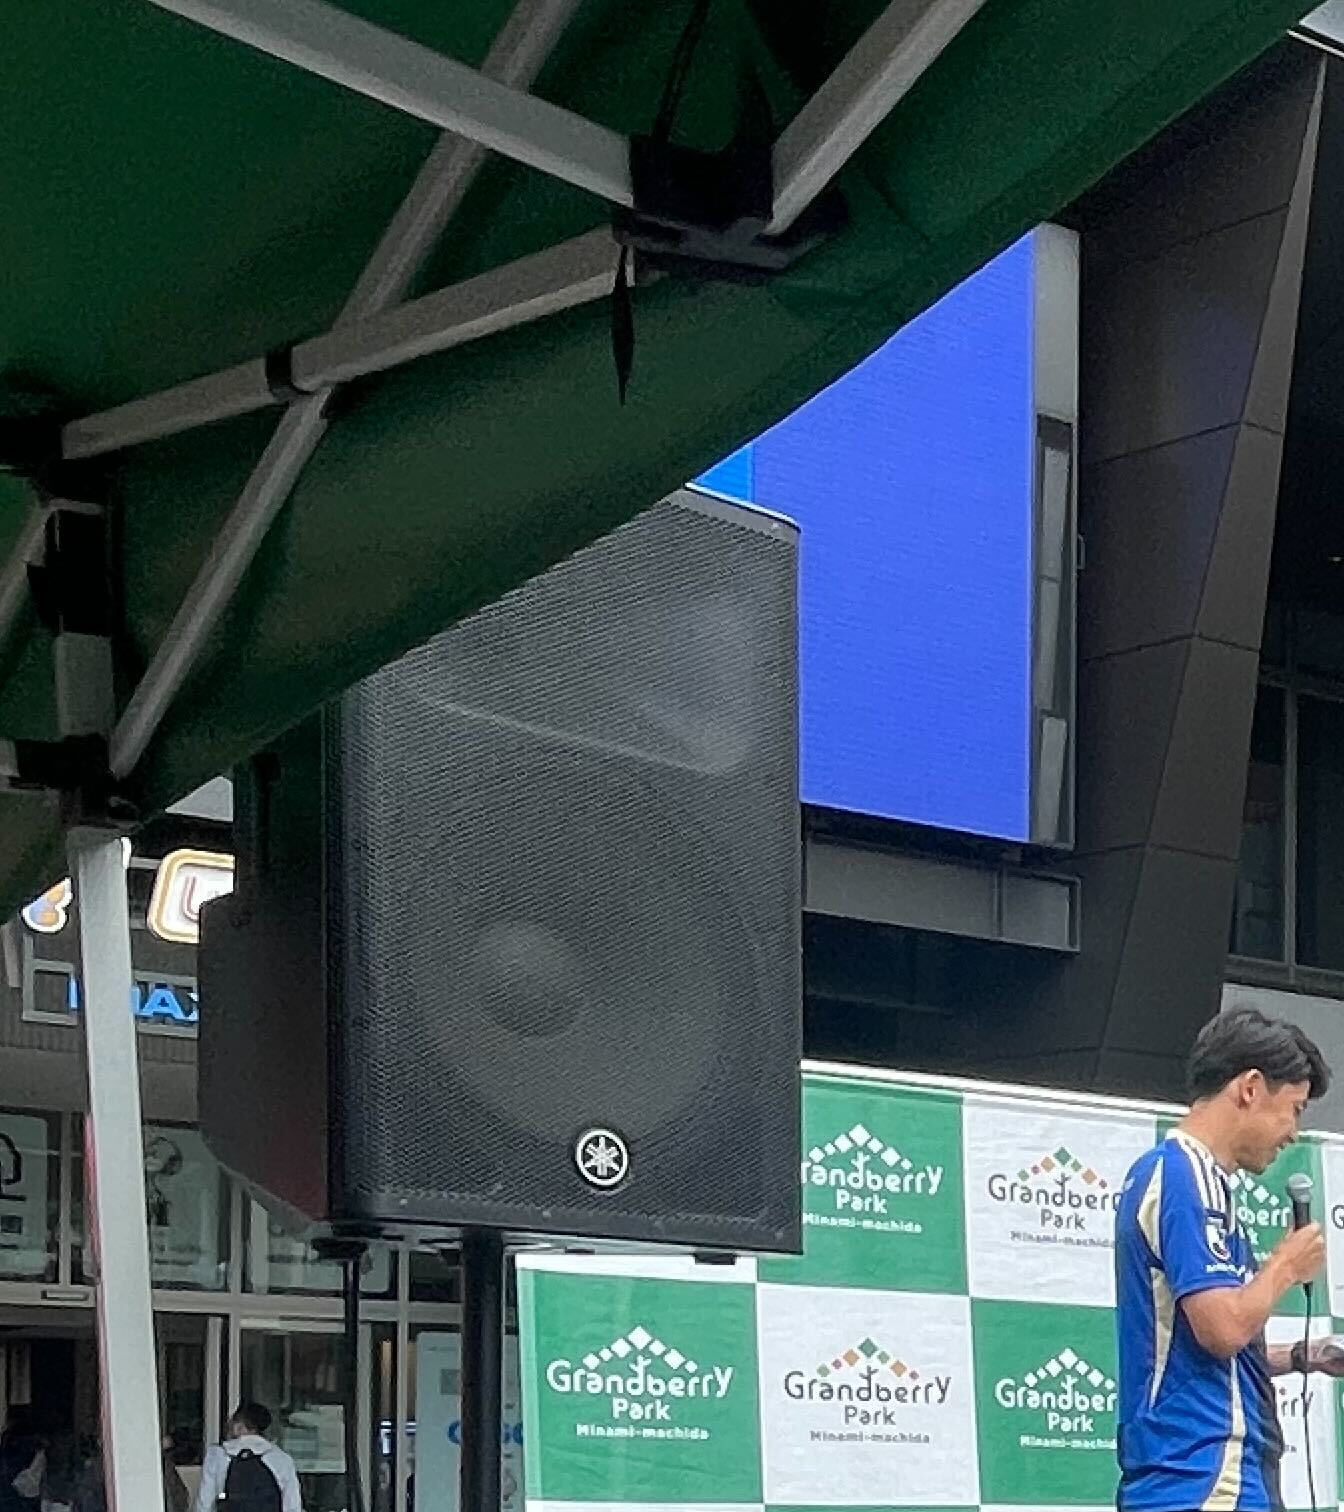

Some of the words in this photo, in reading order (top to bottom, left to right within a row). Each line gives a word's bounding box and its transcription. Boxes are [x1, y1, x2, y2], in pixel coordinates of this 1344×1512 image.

[801, 1151, 944, 1196] randberry
[835, 1188, 888, 1214] Park
[988, 1172, 1122, 1212] Grandberr
[1040, 1208, 1086, 1231] Park
[546, 1355, 734, 1398] Grandberry
[784, 1365, 952, 1405] Grandberry
[995, 1374, 1117, 1412] Grandber
[612, 1397, 672, 1421] Park
[844, 1404, 897, 1427] Park
[576, 1422, 710, 1441] Minami-machida
[1047, 1412, 1095, 1433] Park
